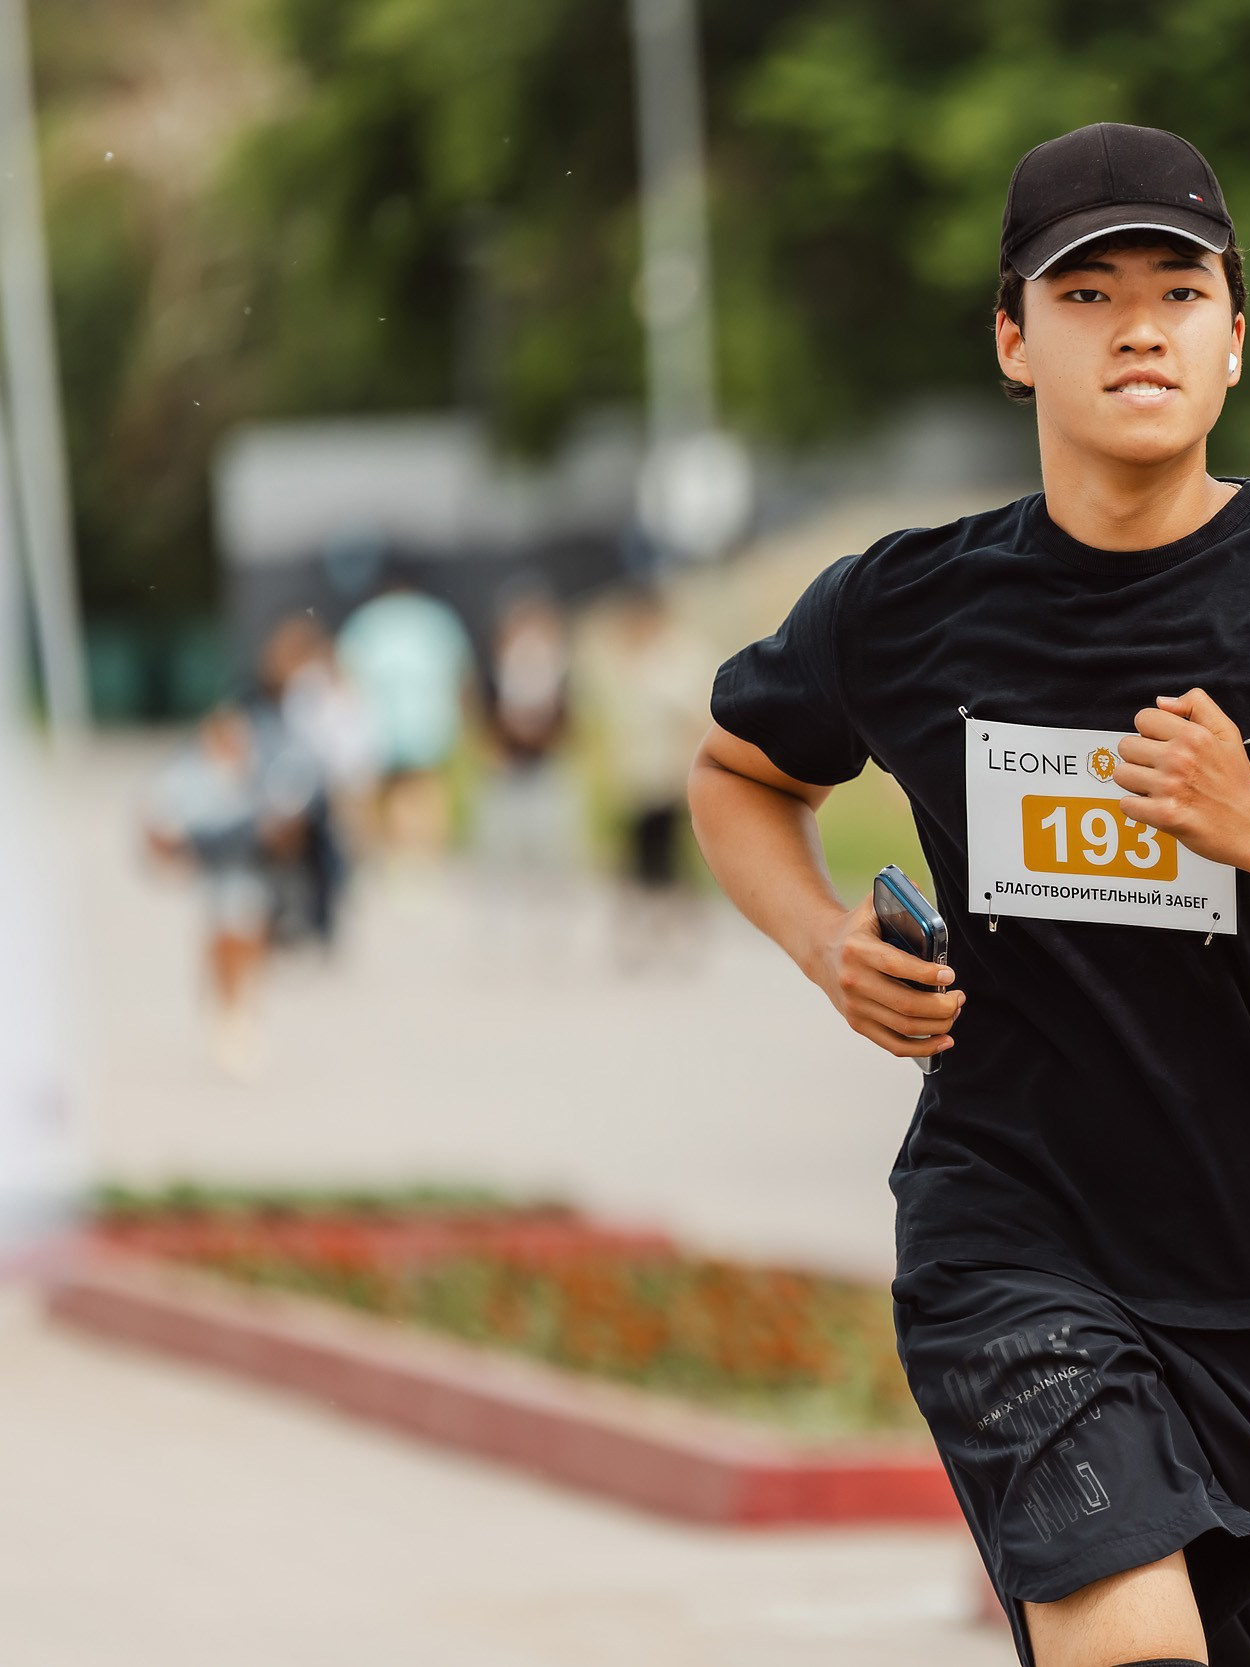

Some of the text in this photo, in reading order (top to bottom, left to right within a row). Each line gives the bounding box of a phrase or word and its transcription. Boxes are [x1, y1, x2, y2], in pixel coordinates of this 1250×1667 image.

[988, 748, 1078, 776] LEONE
[1040, 806, 1161, 869] 193
[995, 880, 1209, 910] БЛАГОТВОРИТЕЛЬНЫЙ ЗАБЕГ
[1015, 1365, 1079, 1404] TRAINING
